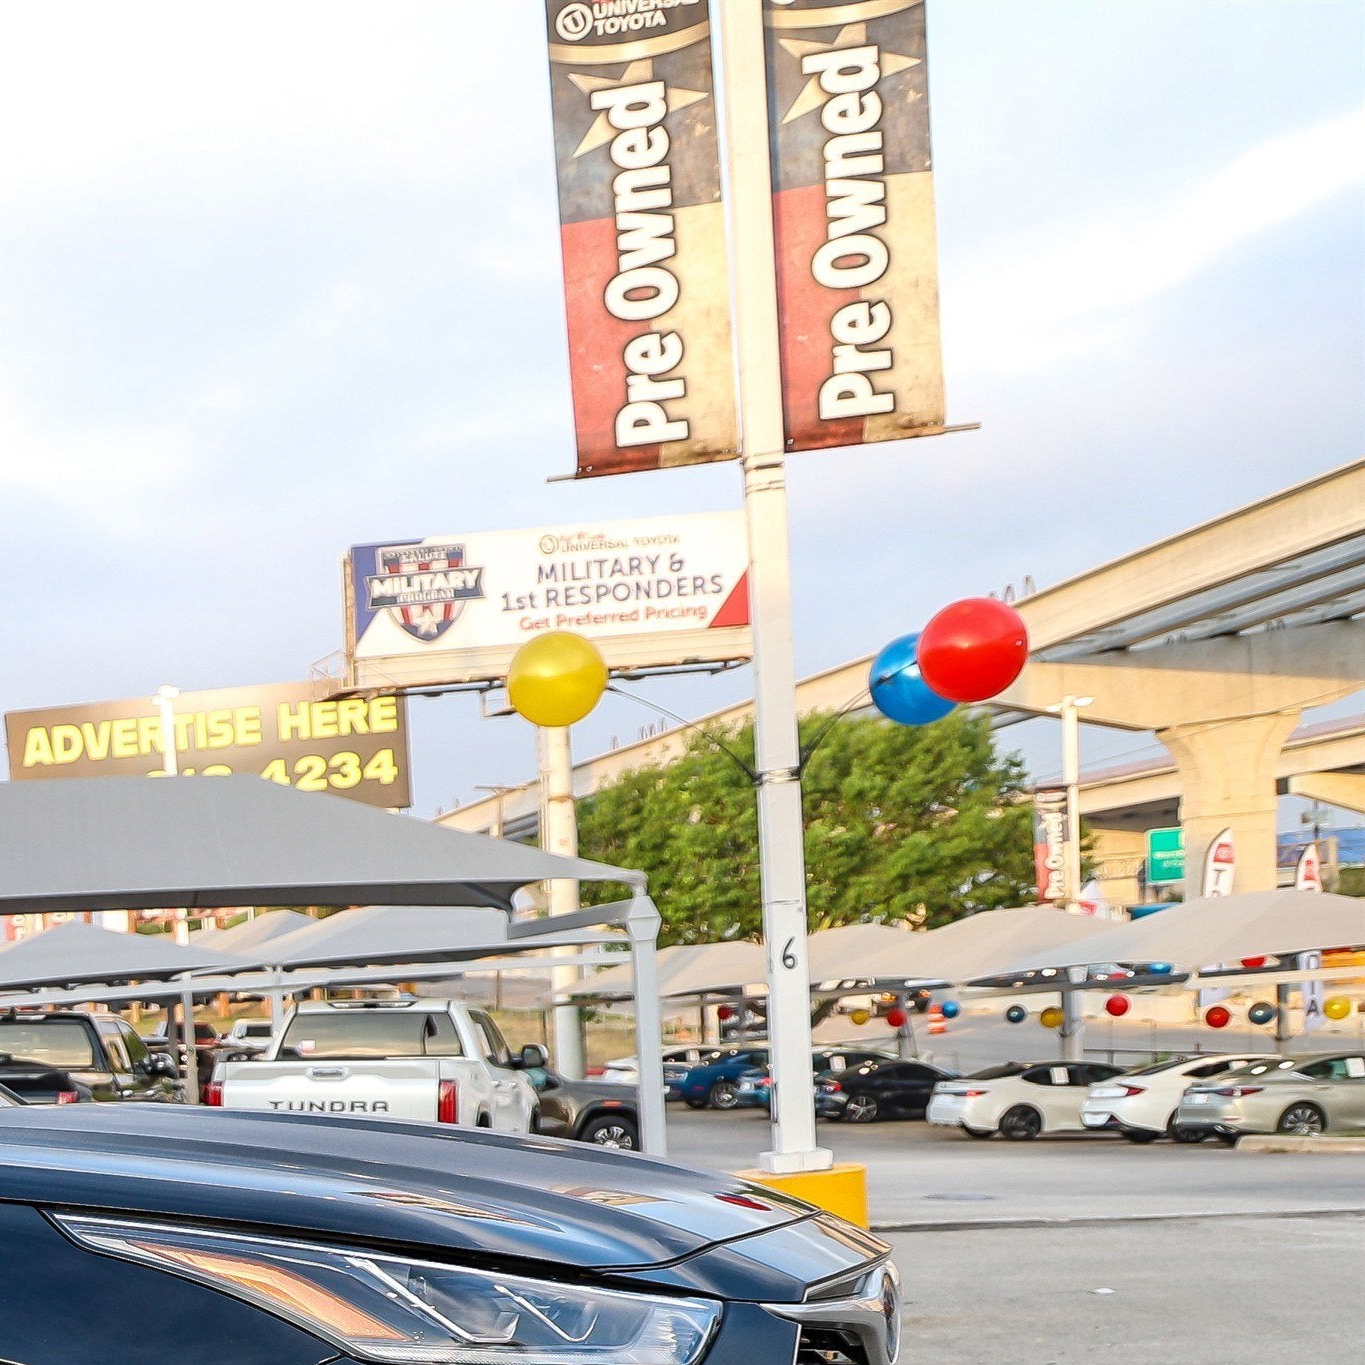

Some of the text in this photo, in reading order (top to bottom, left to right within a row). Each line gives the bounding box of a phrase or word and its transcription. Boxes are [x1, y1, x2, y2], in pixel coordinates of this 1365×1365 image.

[592, 0, 700, 18] UNIVER
[593, 10, 667, 36] TOYOTA
[801, 45, 894, 421] Pre Owned
[590, 81, 689, 448] Pre Owned
[370, 568, 480, 599] MILITARY
[537, 552, 685, 584] MILITARY &
[501, 574, 725, 612] 1st RESPONDERS
[519, 604, 709, 631] Get Preferred Pricing
[23, 696, 399, 768] ADVERTISE HERE
[782, 935, 799, 970] 6
[269, 1100, 389, 1112] TUNDRA
